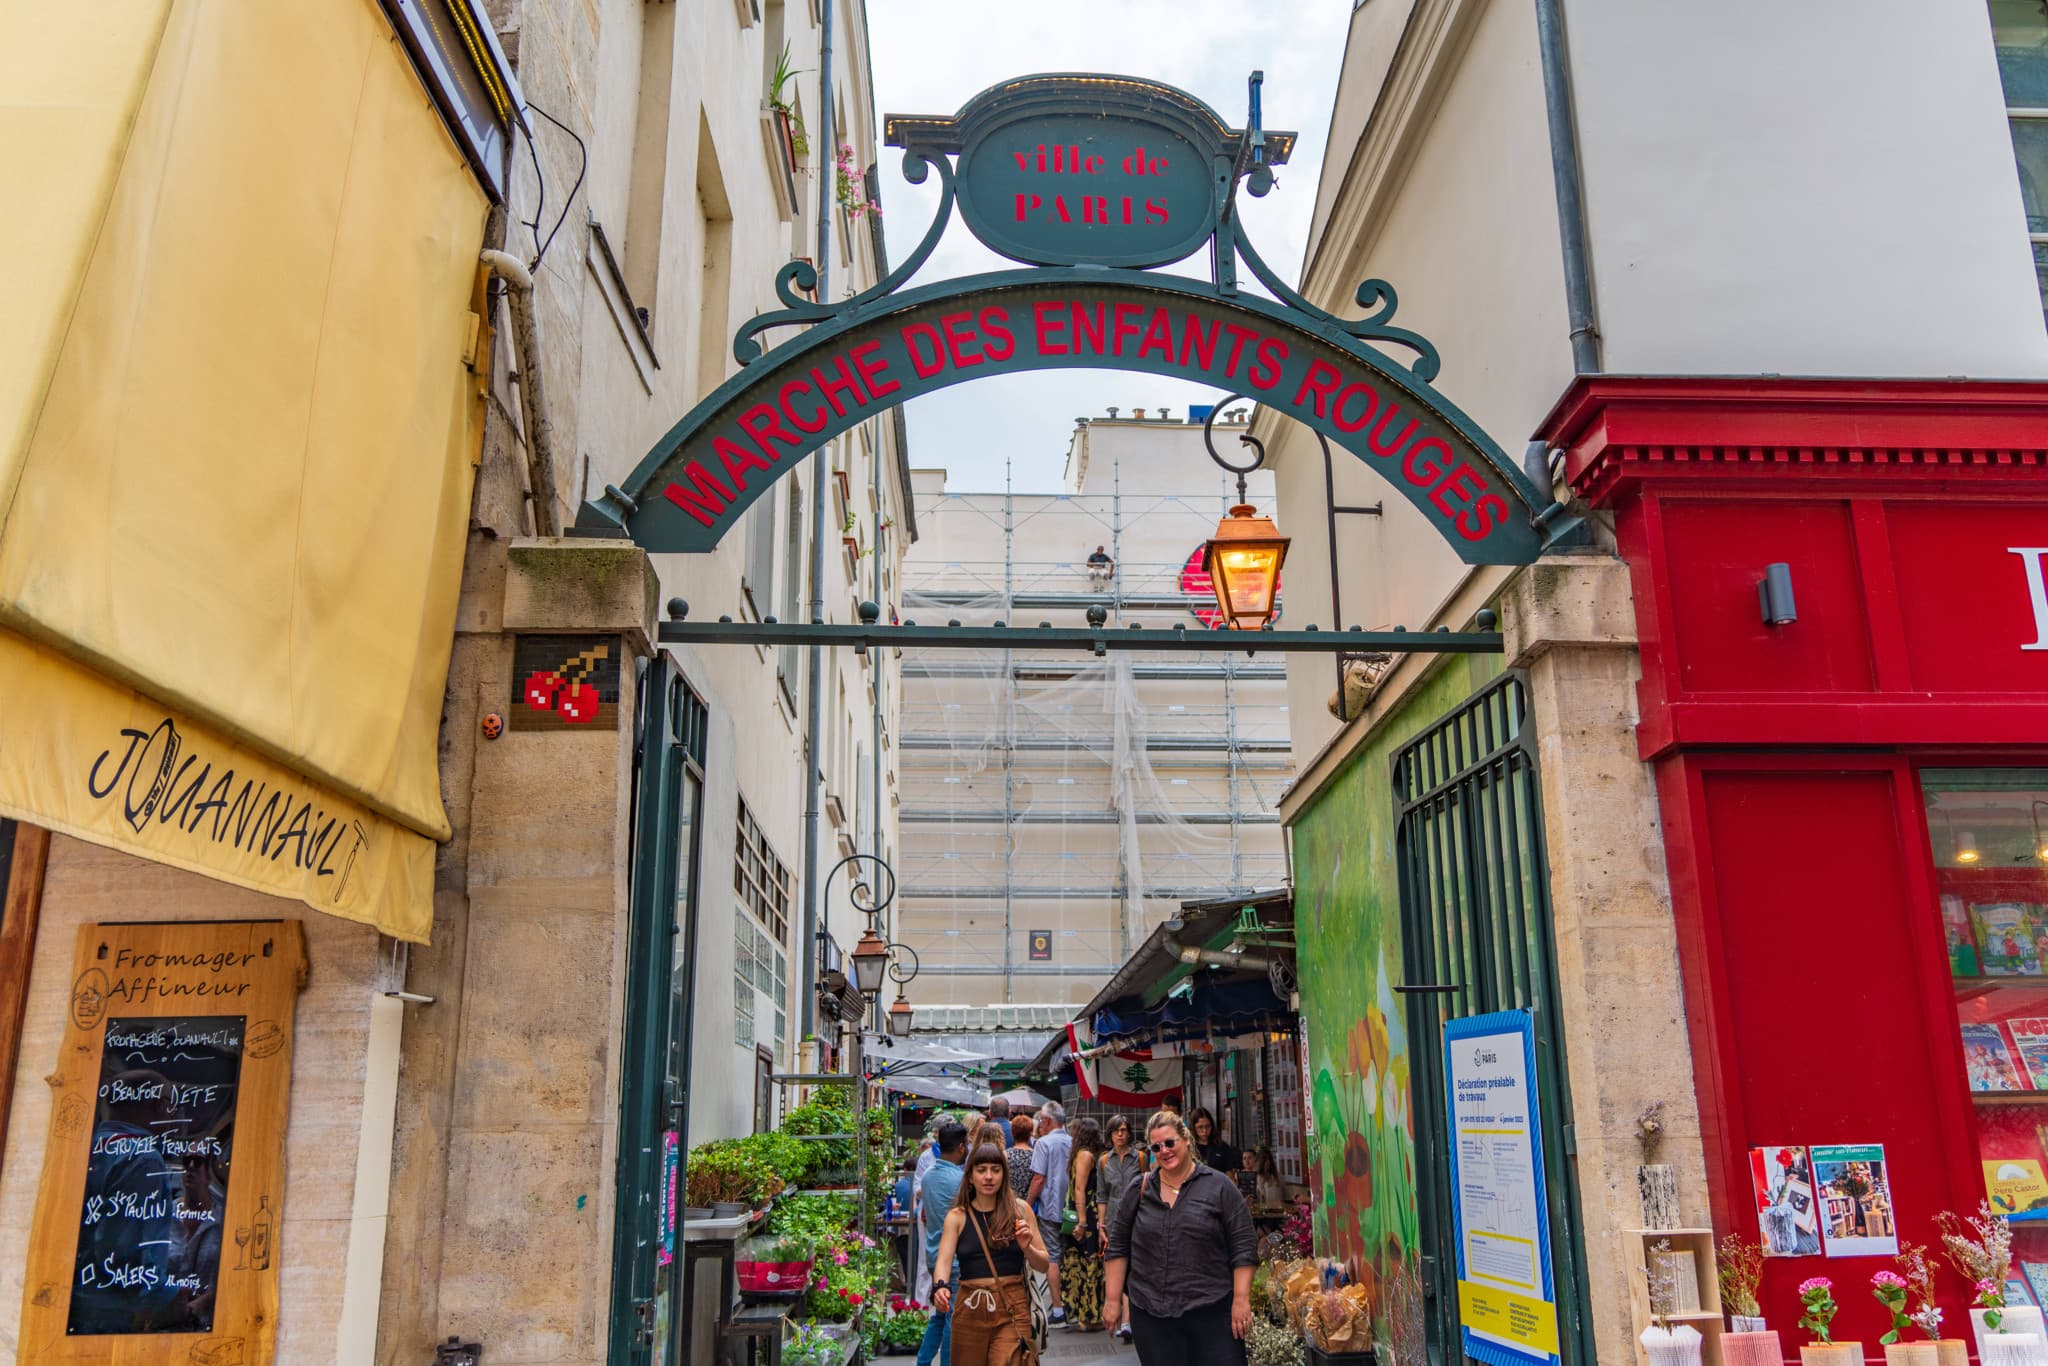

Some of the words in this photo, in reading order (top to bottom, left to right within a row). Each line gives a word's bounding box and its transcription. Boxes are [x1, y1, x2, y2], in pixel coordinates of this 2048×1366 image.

[1012, 144, 1105, 175] ville
[1122, 147, 1169, 176] de
[1013, 193, 1169, 225] PARIS
[662, 339, 901, 528] MARCHE
[900, 305, 1016, 380] DES
[1032, 301, 1290, 391] ENFANTS
[1293, 357, 1510, 542] ROUGES
[115, 948, 256, 972] Fromager
[108, 977, 251, 1003] Affineur
[1482, 1053, 1497, 1064] PARIS
[110, 1079, 165, 1104] BEAUFORT
[1457, 1077, 1488, 1090] Déclaration
[1488, 1076, 1516, 1090] préalable
[1458, 1092, 1466, 1102] de
[1466, 1092, 1486, 1102] travaux
[97, 1252, 160, 1291] SALERS
